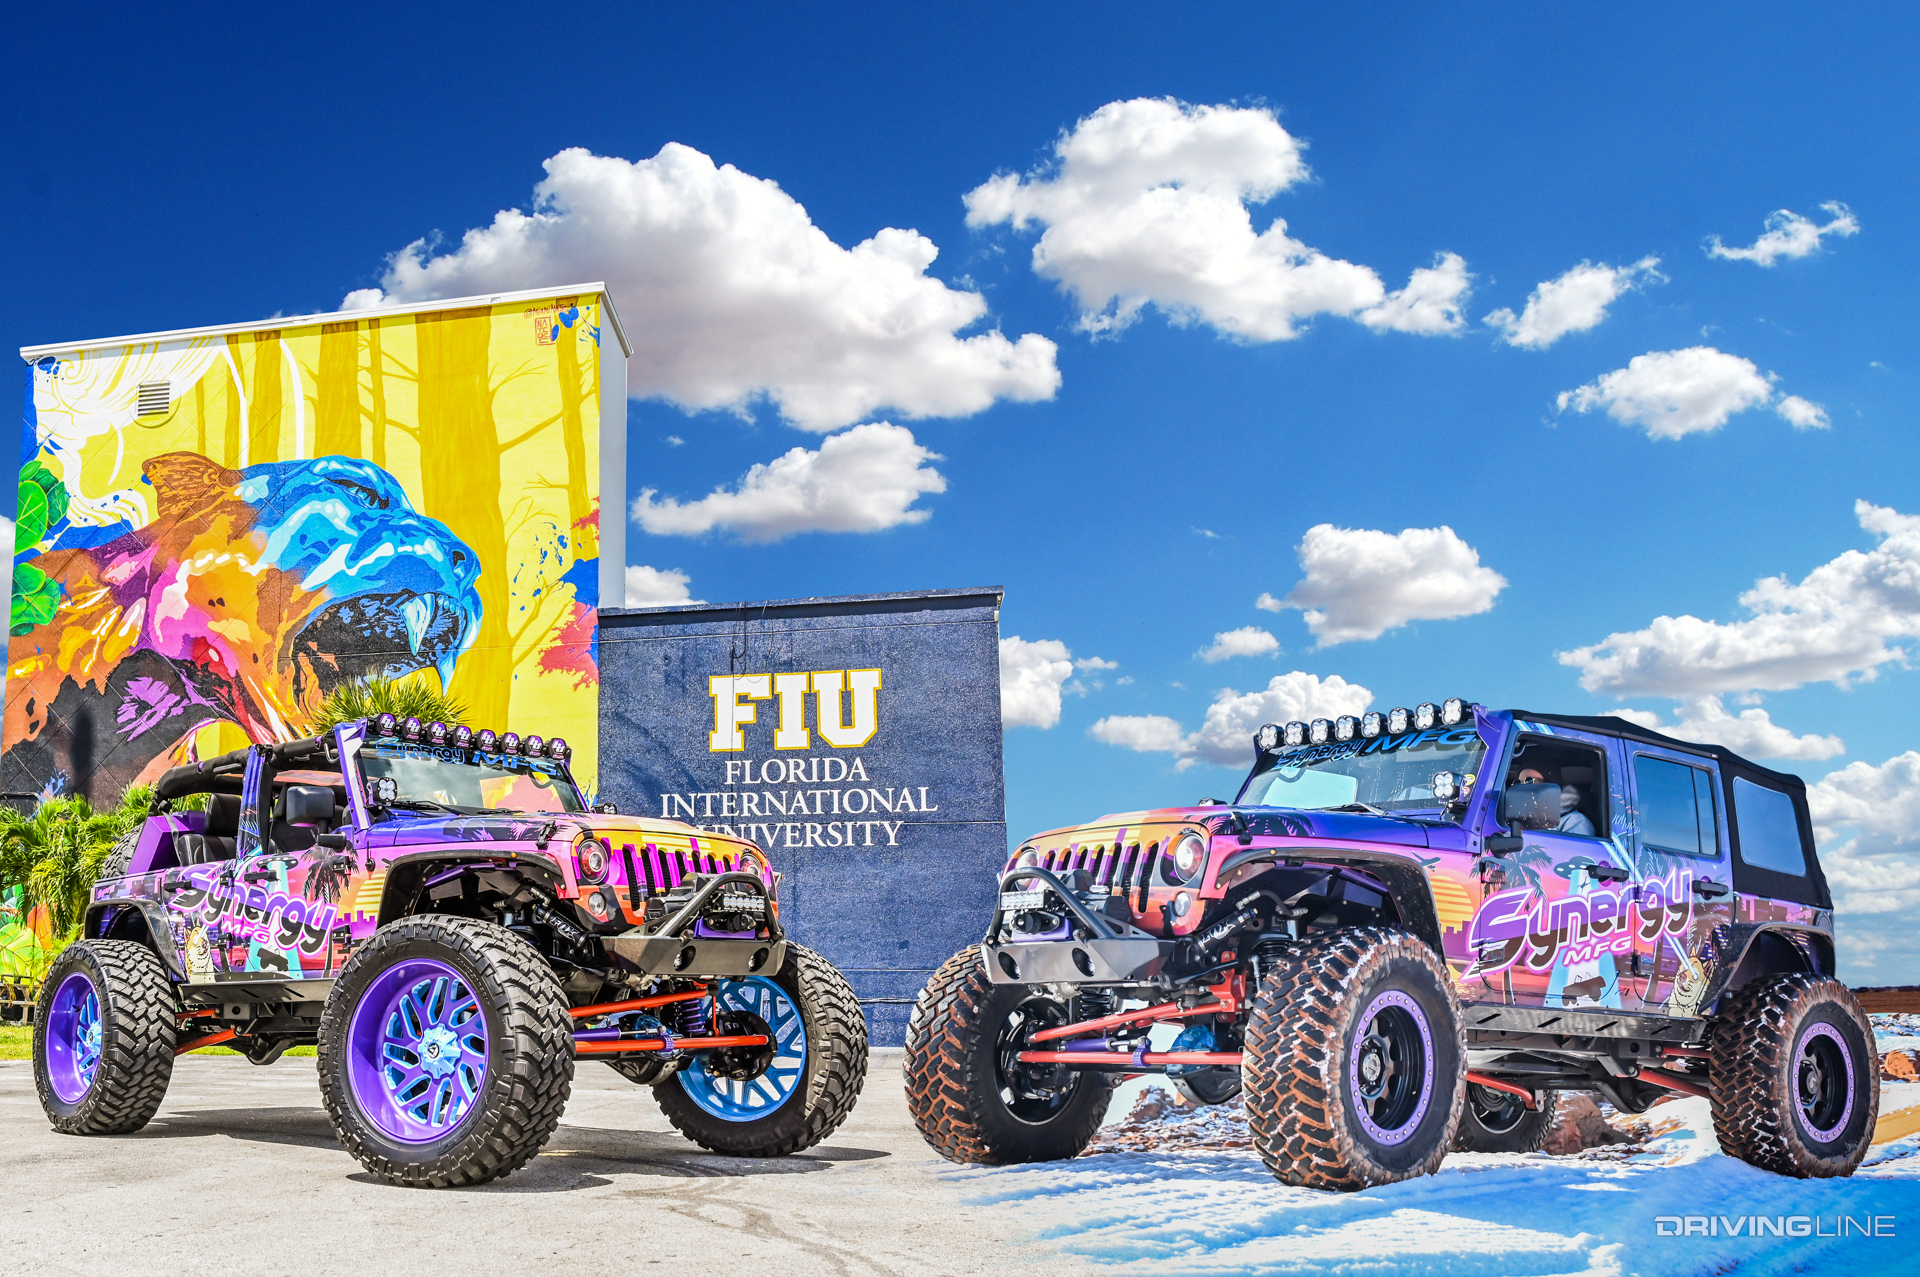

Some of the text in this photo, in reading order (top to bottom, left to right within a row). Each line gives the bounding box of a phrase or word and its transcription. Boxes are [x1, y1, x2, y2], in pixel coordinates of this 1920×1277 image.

[709, 668, 882, 752] FIU
[376, 735, 465, 765] Synergy
[1271, 739, 1367, 770] Synergy
[724, 757, 870, 785] FLORIDA
[660, 787, 939, 818] INTERNATIONAL
[696, 820, 904, 848] IVERSITY
[169, 861, 338, 956] Synergy
[221, 921, 270, 944] MFG
[1461, 869, 1694, 981] Synergy
[1563, 936, 1632, 965] MFG
